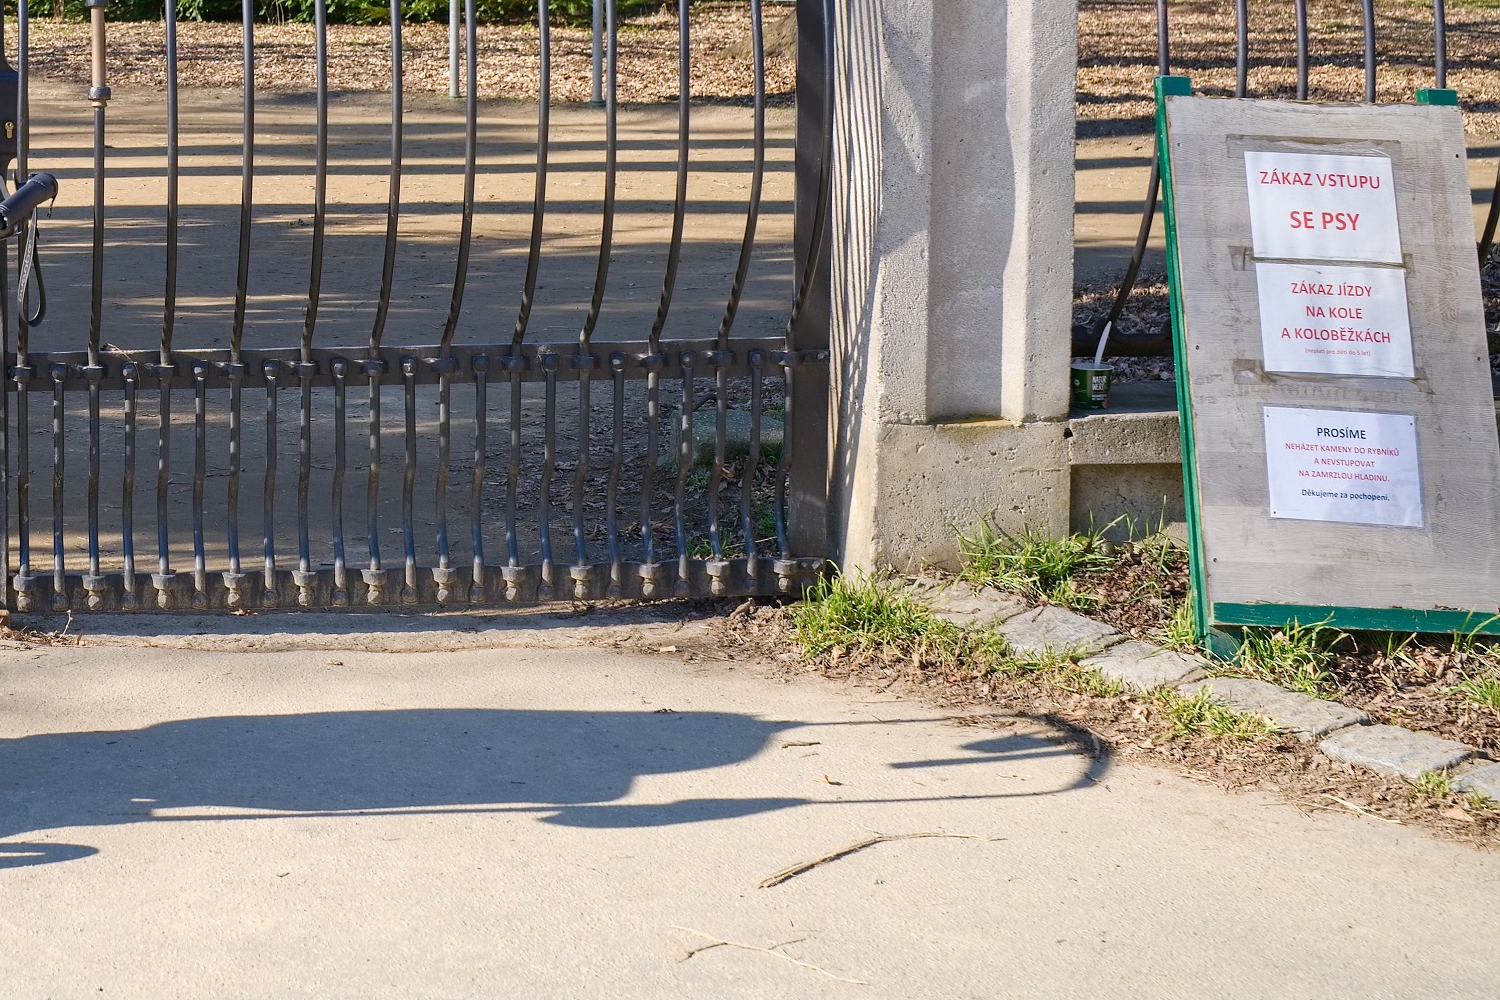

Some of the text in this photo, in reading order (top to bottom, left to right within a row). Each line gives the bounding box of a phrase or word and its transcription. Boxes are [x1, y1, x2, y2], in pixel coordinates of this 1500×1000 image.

[1260, 168, 1380, 189] ZÁKAZ VSTUPU
[1290, 211, 1360, 231] SE PSY
[1291, 280, 1372, 297] ZÁKAZ JÍZDY
[1306, 306, 1363, 319] NA KOLE
[1281, 327, 1391, 344] A KOLOBĚŽKÁCH
[1316, 427, 1367, 440] PROSÍME
[1285, 443, 1318, 451] NEHÁZET
[1320, 445, 1352, 453] KAMENY
[1367, 447, 1400, 456] RYBNÍKŮ
[1321, 458, 1375, 468] NEVSTUPOVAT
[1311, 470, 1353, 480] ZAMRZLOU
[1354, 473, 1390, 482] HLADINU.
[1301, 489, 1338, 499] Děkujeme
[1349, 492, 1391, 502] pochopení.
